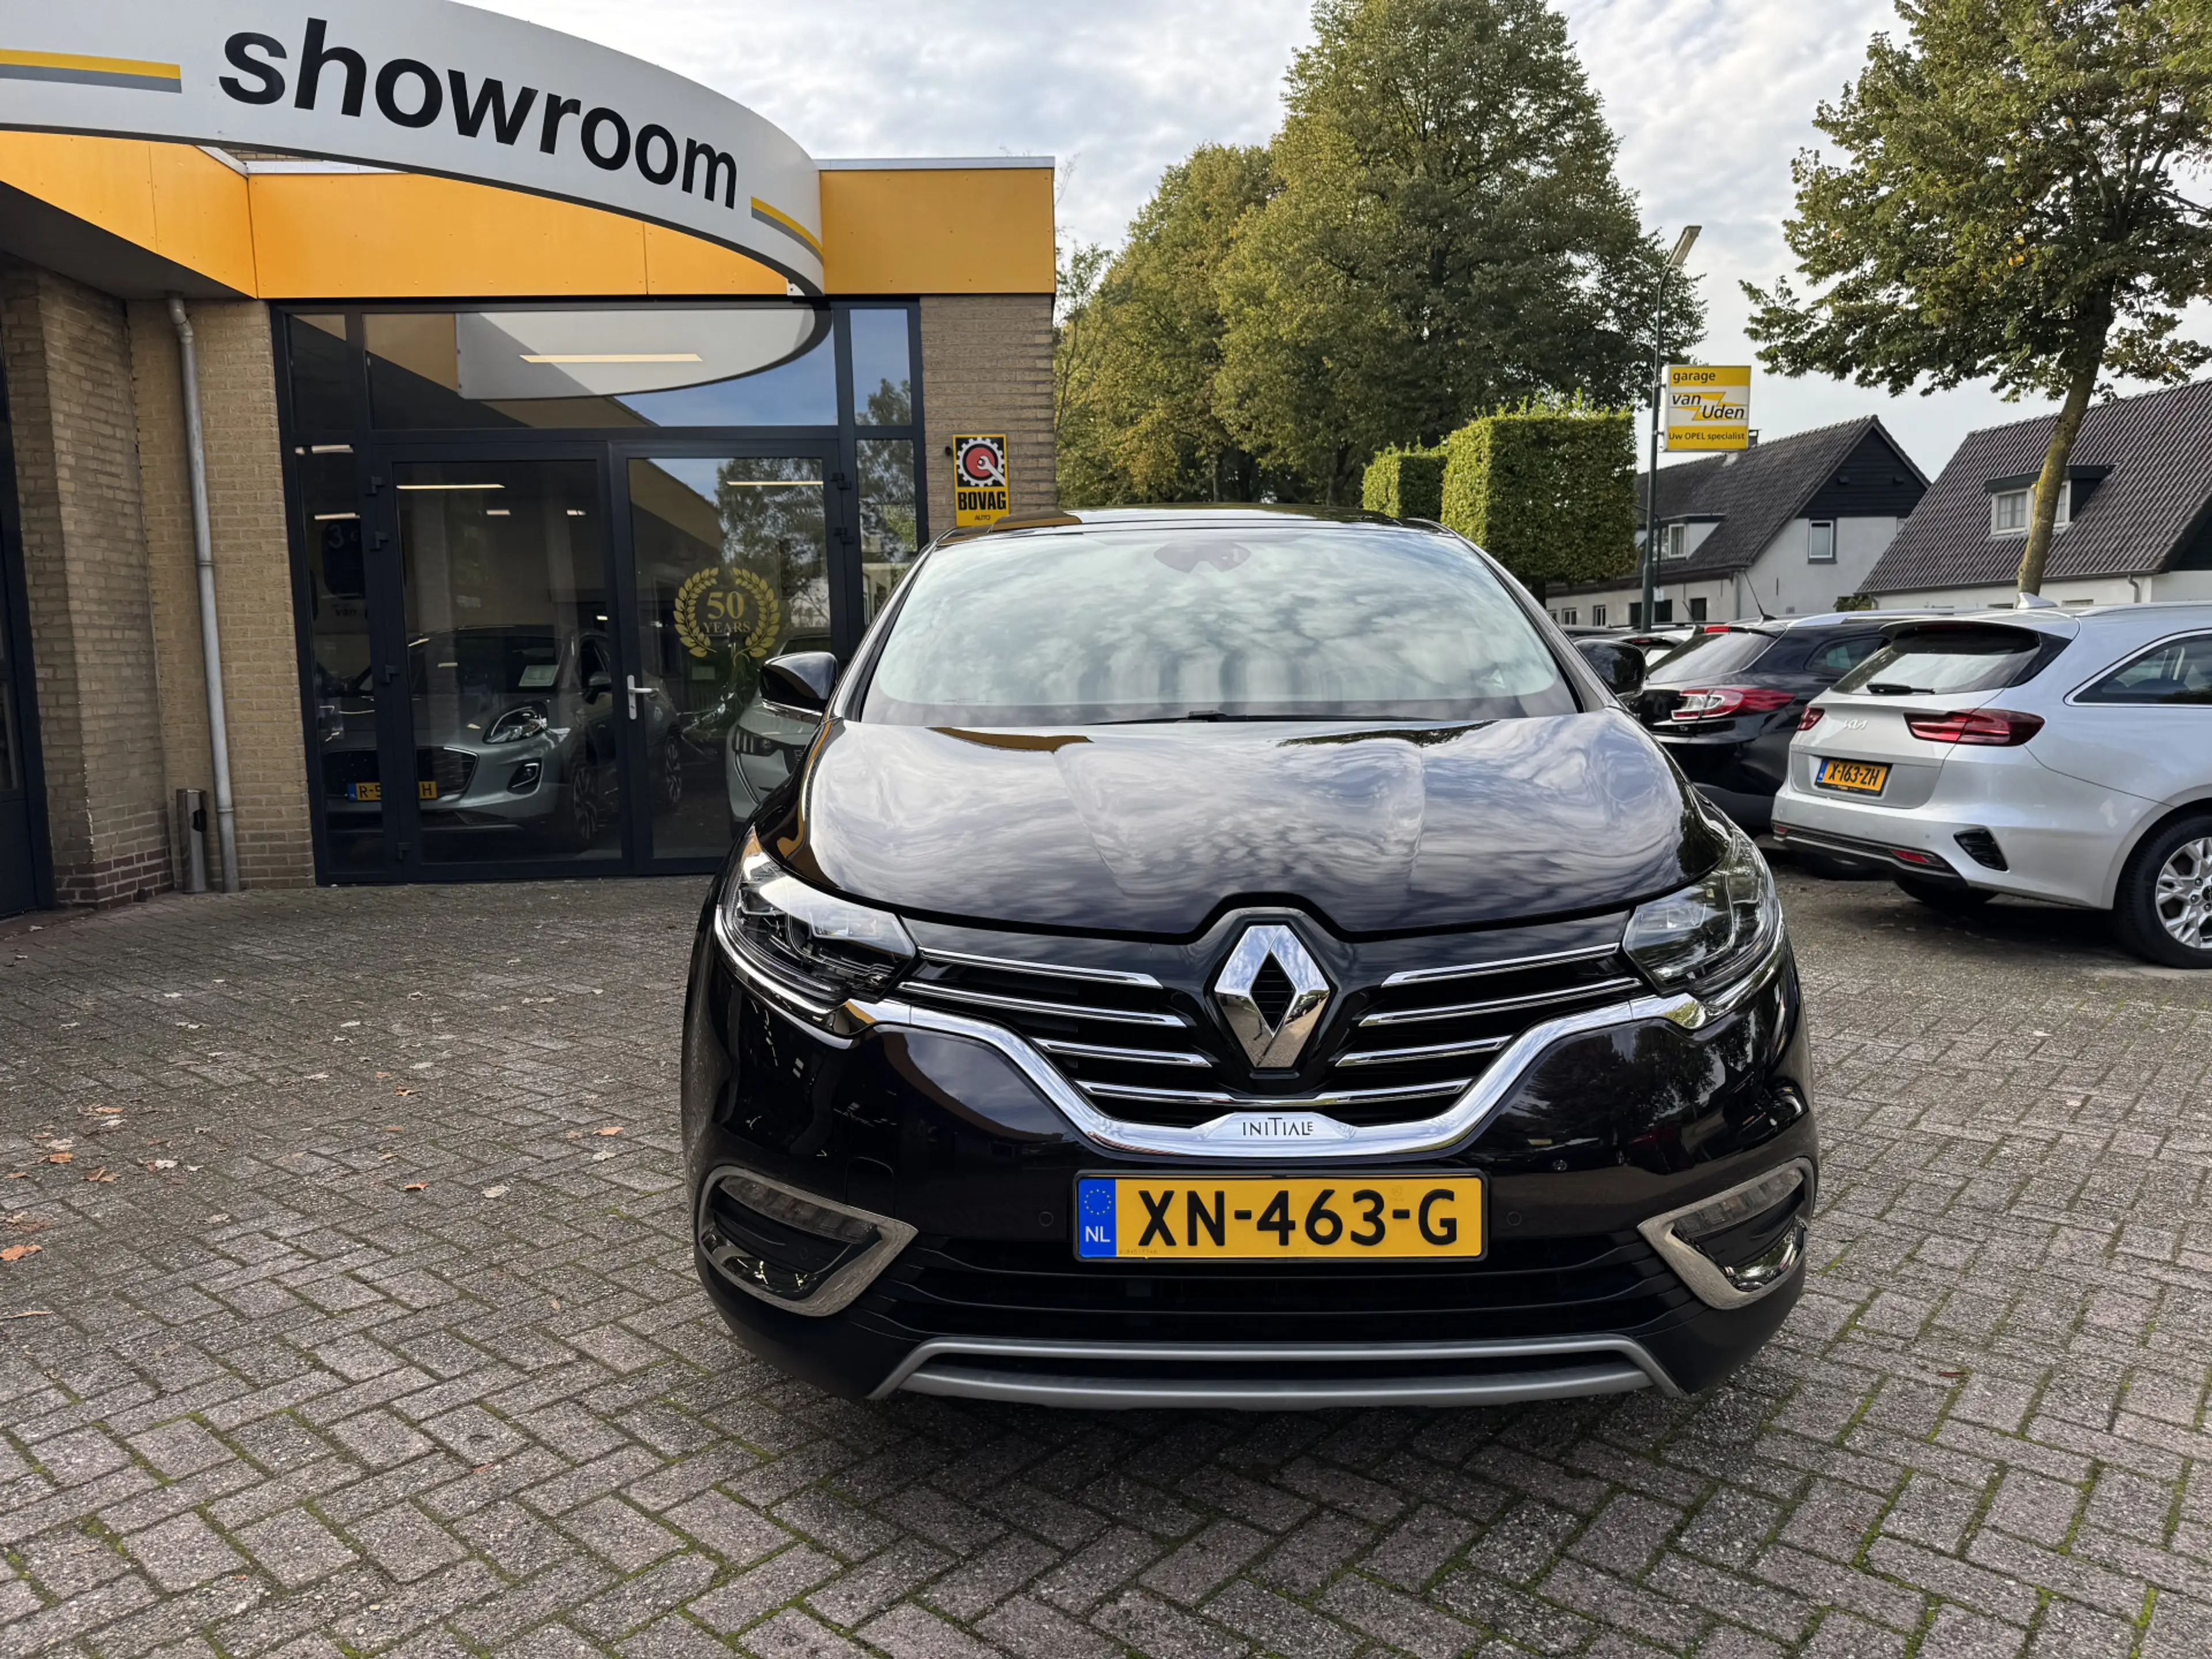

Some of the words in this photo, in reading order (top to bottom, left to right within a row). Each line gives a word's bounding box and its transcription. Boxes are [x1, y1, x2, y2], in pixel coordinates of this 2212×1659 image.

[219, 17, 738, 209] showroom
[1672, 372, 1716, 384] garage
[1672, 394, 1701, 406] van
[1702, 404, 1744, 419] Uden
[1684, 432, 1706, 440] OPEL
[1707, 432, 1745, 441] specialist
[958, 491, 1007, 510] BOVAG
[707, 590, 744, 620] 50
[702, 621, 751, 634] YEARS
[1828, 763, 1880, 786] X-163-ZH
[1243, 1117, 1313, 1136] INITIALE
[1085, 1225, 1111, 1243] NL
[1138, 1189, 1457, 1246] XN-463-G
